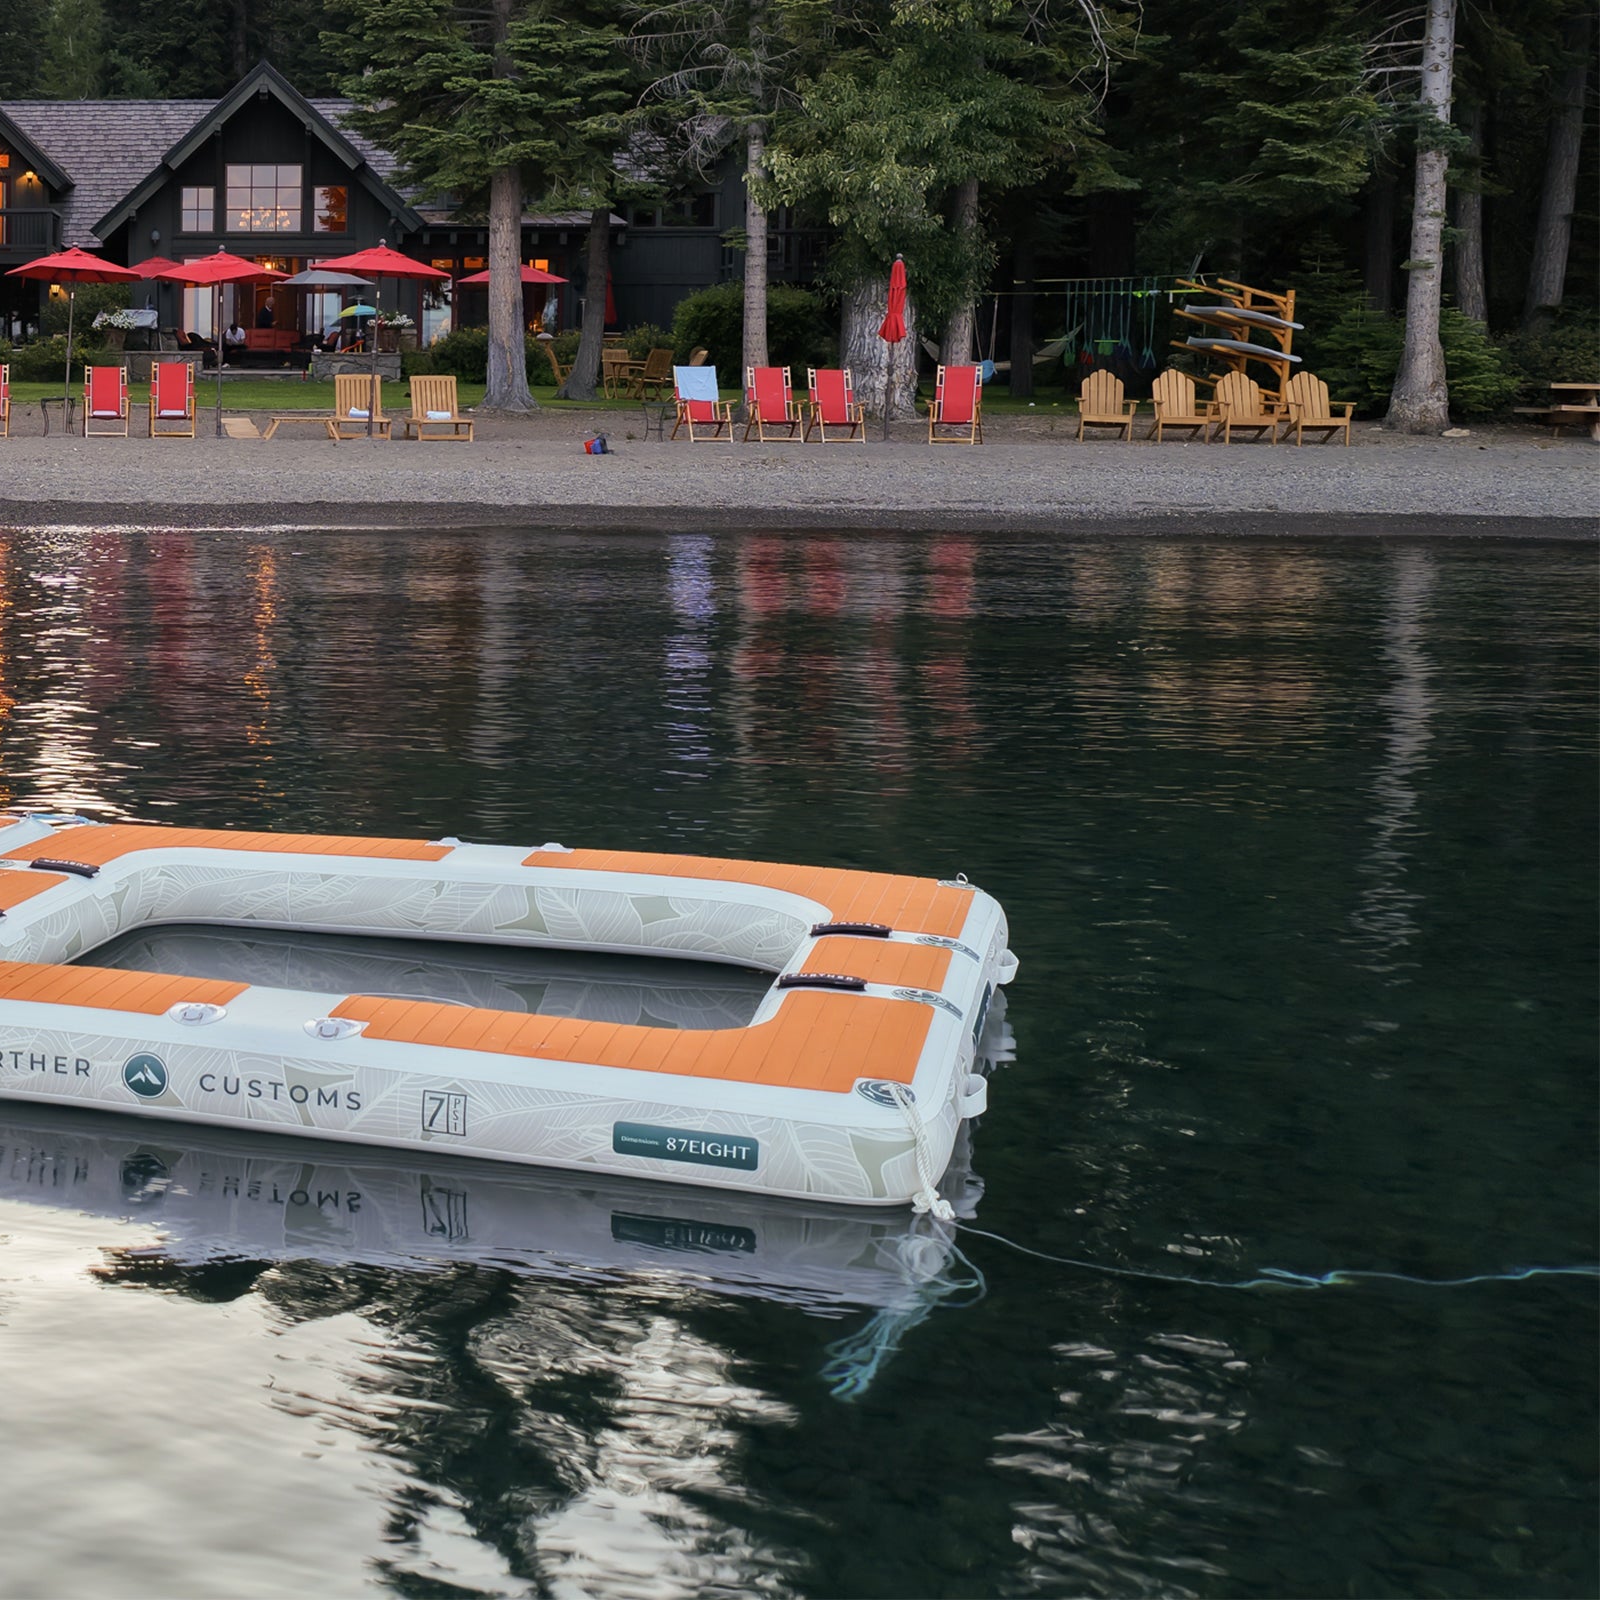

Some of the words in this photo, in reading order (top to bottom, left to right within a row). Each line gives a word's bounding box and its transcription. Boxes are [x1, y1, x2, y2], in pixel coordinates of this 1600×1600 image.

[199, 1073, 361, 1111] CUSTOMS
[428, 1096, 446, 1127] 7
[453, 1098, 461, 1132] PSI
[666, 1137, 751, 1160] 87EIGHT
